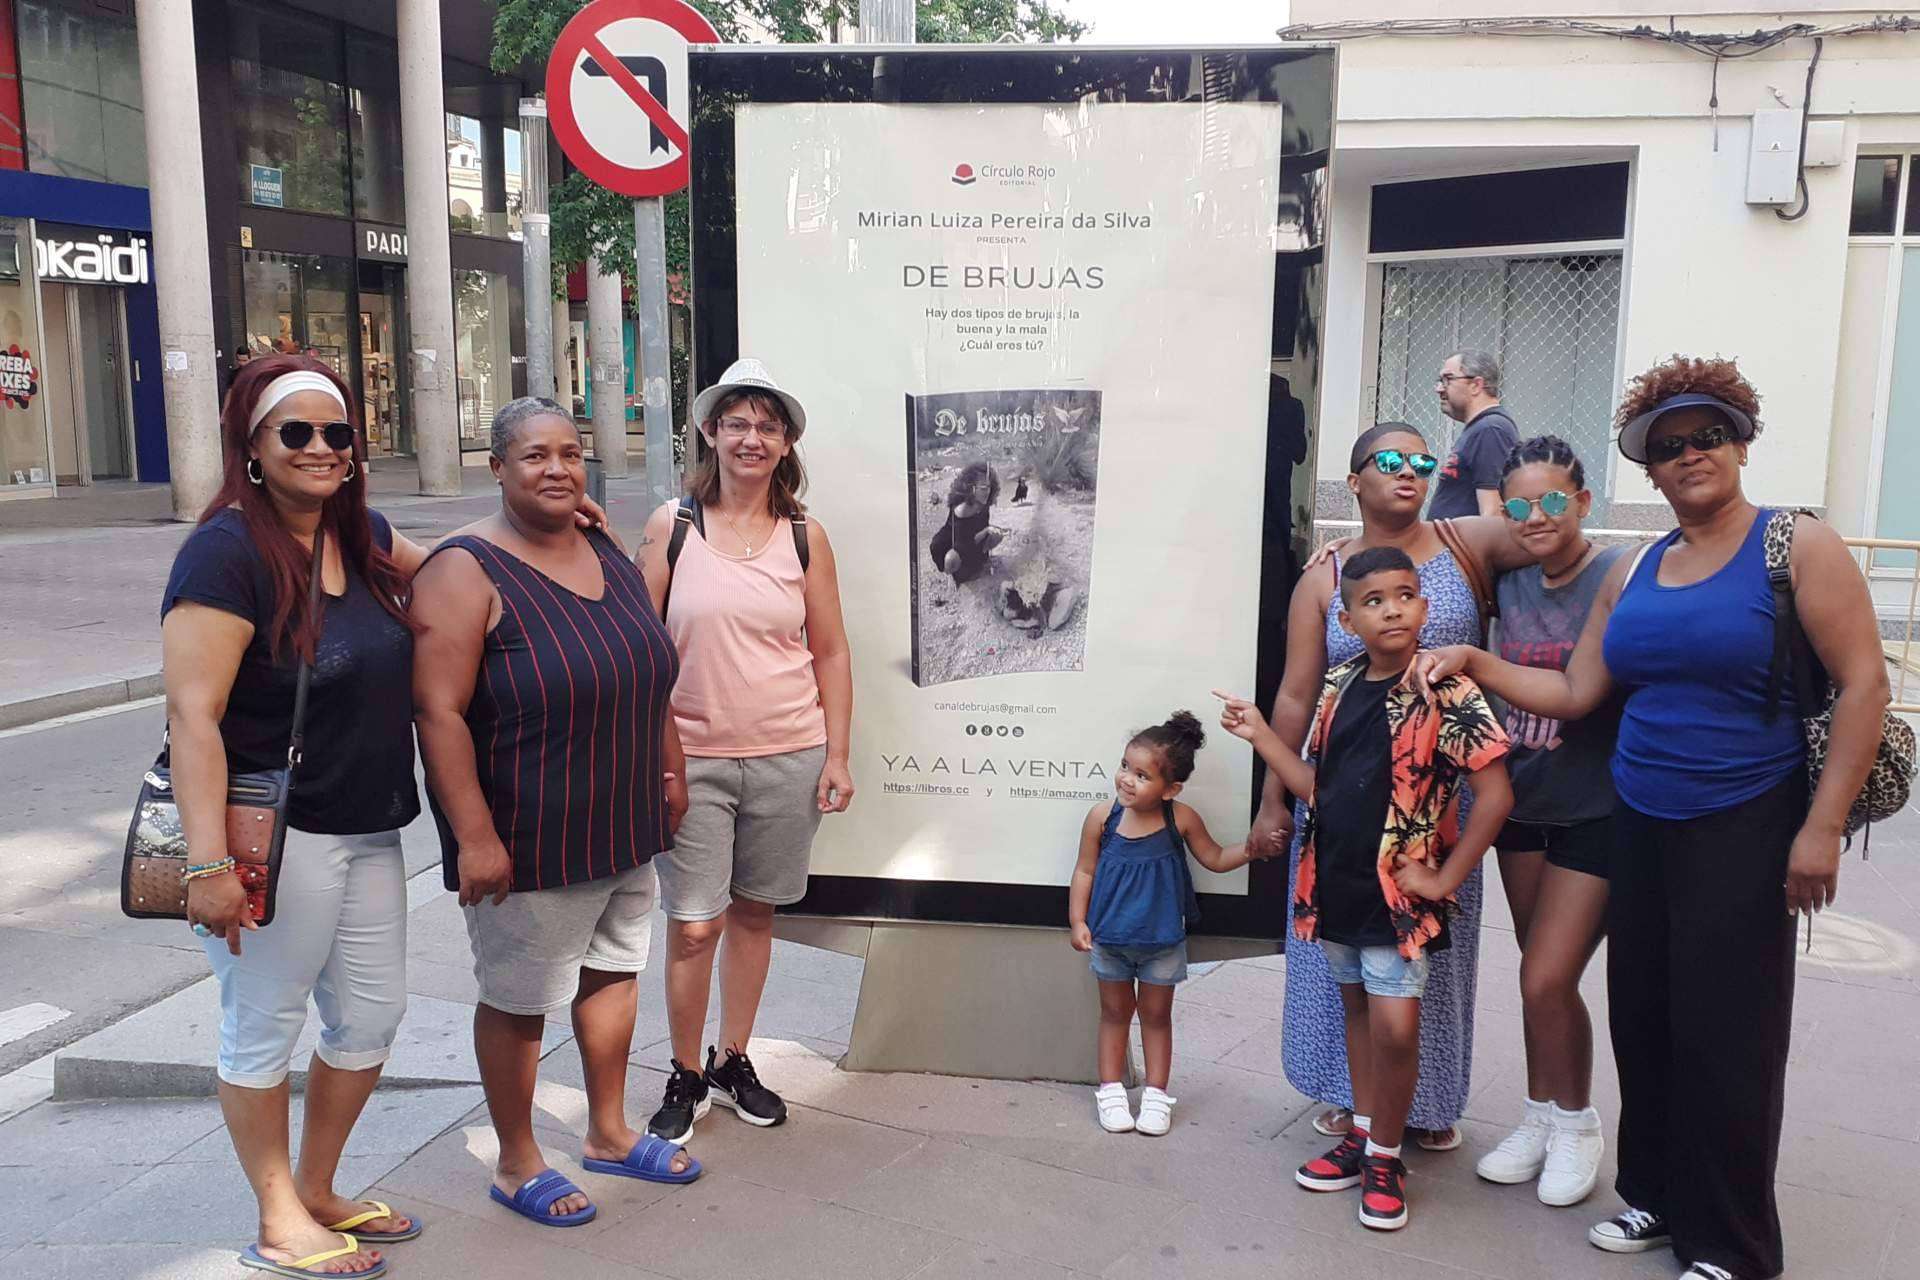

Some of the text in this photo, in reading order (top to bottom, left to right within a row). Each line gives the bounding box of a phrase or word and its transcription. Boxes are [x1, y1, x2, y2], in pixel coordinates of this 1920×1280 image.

[981, 164, 1056, 181] Círculo Rojo
[857, 210, 1152, 229] Mirian Luiza Pereira da Silva
[976, 236, 1027, 244] PRESENTA
[903, 265, 1105, 289] DE BRUJAS
[925, 307, 948, 320] Hay
[950, 308, 972, 319] dos
[975, 308, 1004, 321] tipos
[1007, 308, 1022, 319] de
[1069, 308, 1080, 320] la
[956, 323, 1047, 336] buena y la mala
[959, 339, 1044, 352] ¿Cuál eres tú?
[0, 355, 33, 374] REBA
[934, 406, 1045, 437] De brujas
[934, 700, 1057, 715] canaldebrujas@gmail.com
[881, 754, 1107, 779] YA A LA VENTA
[883, 781, 1109, 800] https://libros.cc y https://amazon.es
